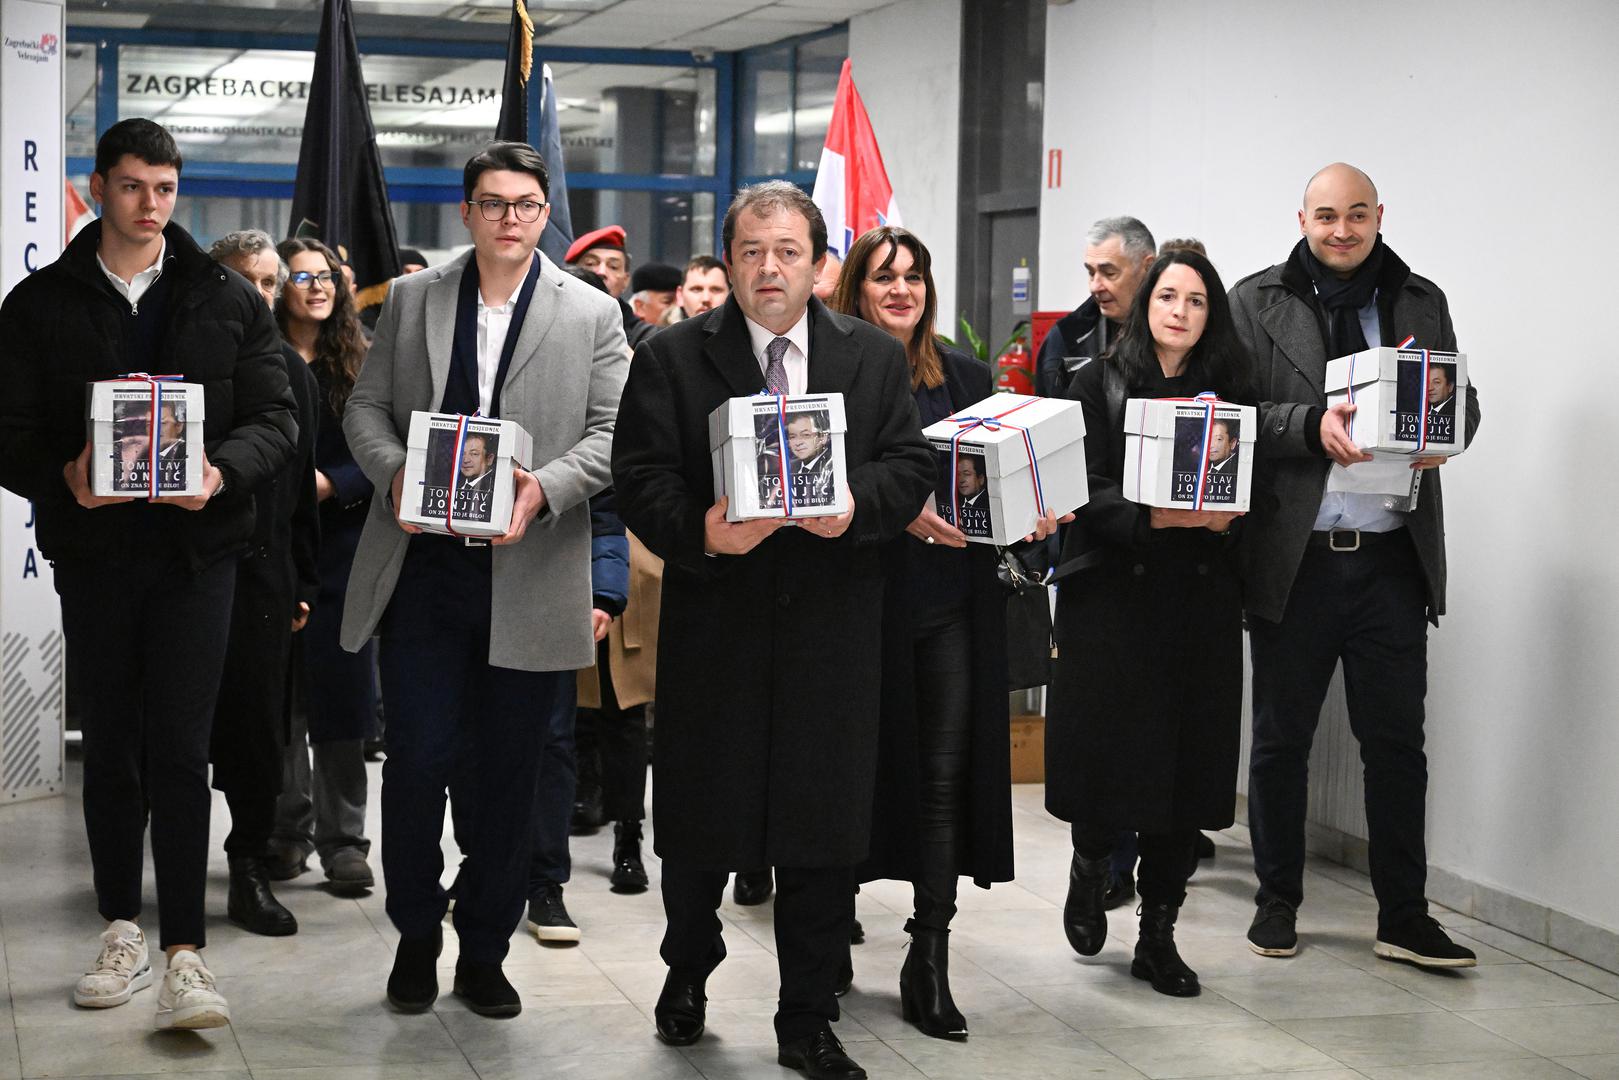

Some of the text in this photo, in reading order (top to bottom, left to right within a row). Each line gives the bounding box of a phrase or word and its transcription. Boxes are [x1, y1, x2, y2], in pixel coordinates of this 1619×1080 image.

[366, 83, 496, 105] ELESAJAM
[431, 421, 457, 429] HRVATSK
[1400, 423, 1450, 435] JOJIĆ
[120, 461, 180, 471] TOMILAV
[119, 470, 181, 482] JONIĆ
[1176, 483, 1232, 494] JOJIĆ
